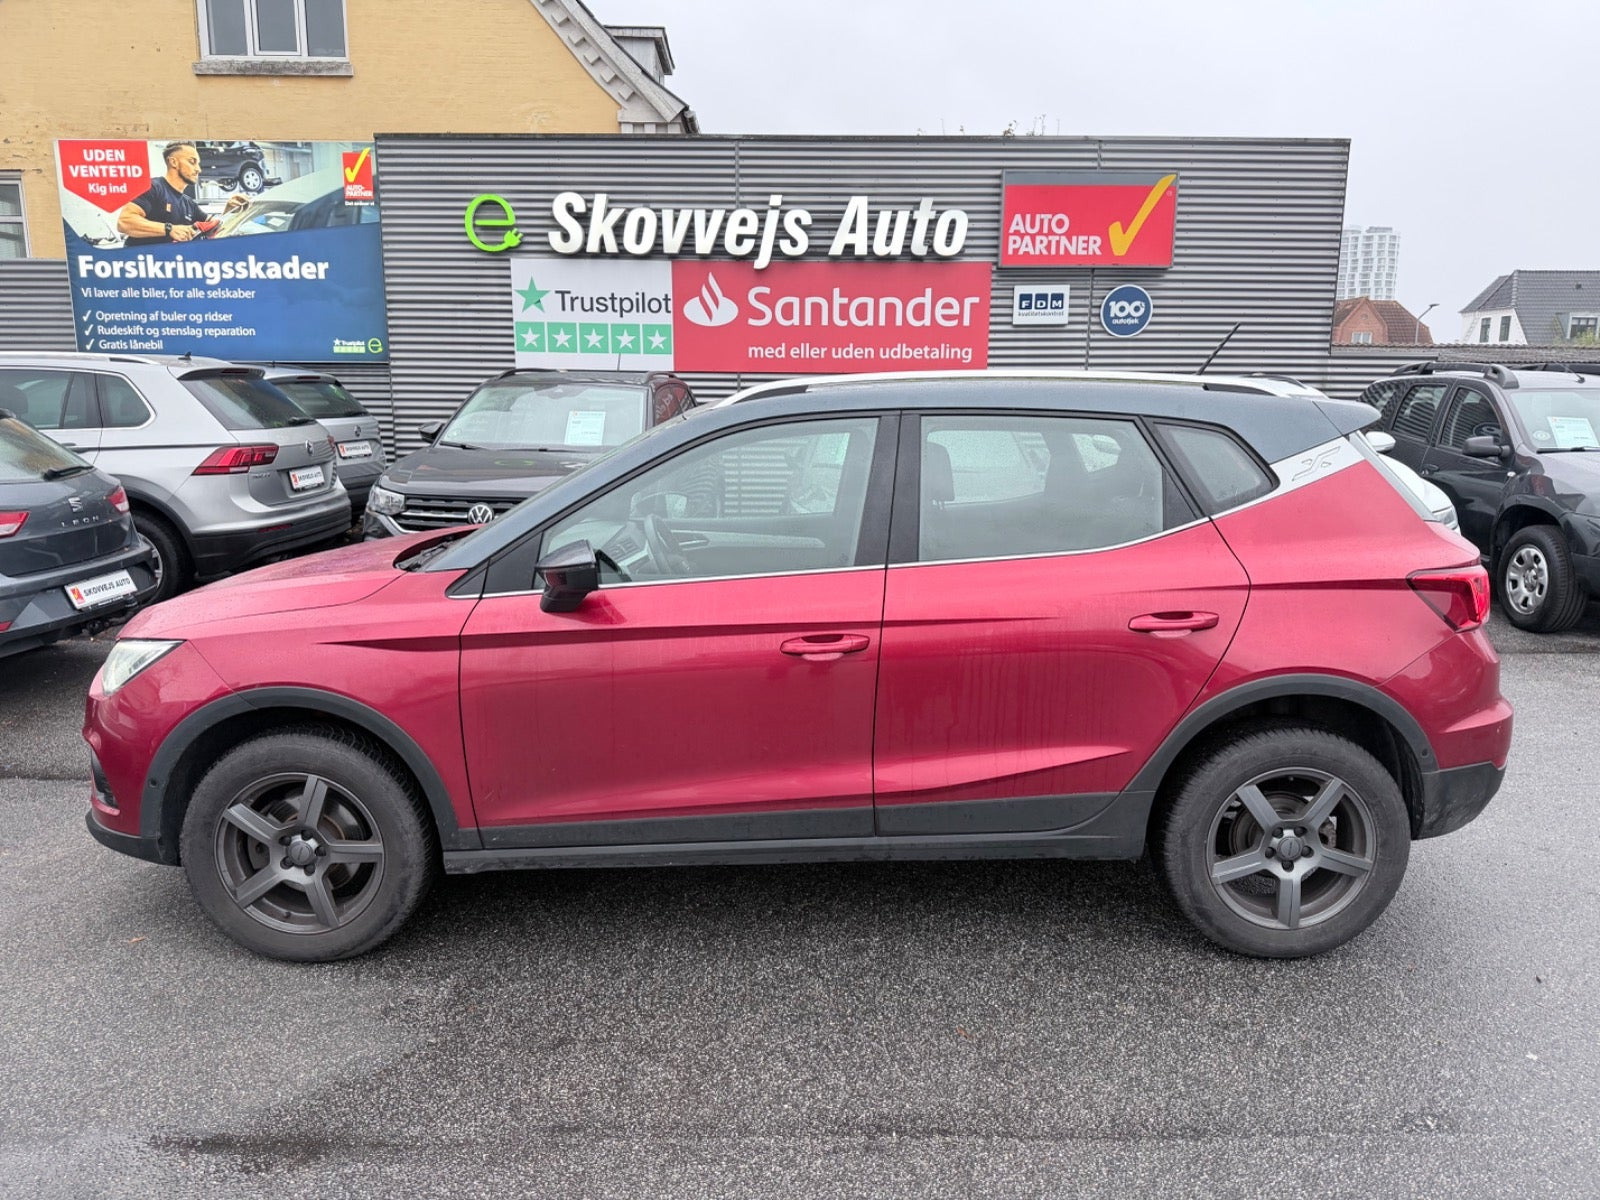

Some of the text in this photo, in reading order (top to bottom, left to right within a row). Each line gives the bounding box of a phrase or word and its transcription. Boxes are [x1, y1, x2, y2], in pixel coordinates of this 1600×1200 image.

[83, 149, 125, 161] UDEN
[68, 165, 143, 178] VENTETID
[88, 183, 128, 196] Kig ind
[1008, 213, 1070, 234] AUTO
[548, 191, 969, 270] Skovvejs Auto
[1007, 235, 1102, 255] PARTNER
[77, 254, 329, 285] Forsikringsskader
[81, 288, 256, 299] Vi laver alle biler, for alle selskaber
[554, 290, 672, 318] Trustpilot
[747, 286, 980, 327] Santander
[1020, 297, 1063, 309] FDM
[95, 311, 233, 323] Opretning af buler og ridser
[97, 325, 256, 338] Rudeskift og stenslag reparation
[99, 339, 163, 350] Gratis lånebil
[748, 343, 972, 363] med eller uden udbetaling
[115, 577, 131, 588] AUTO
